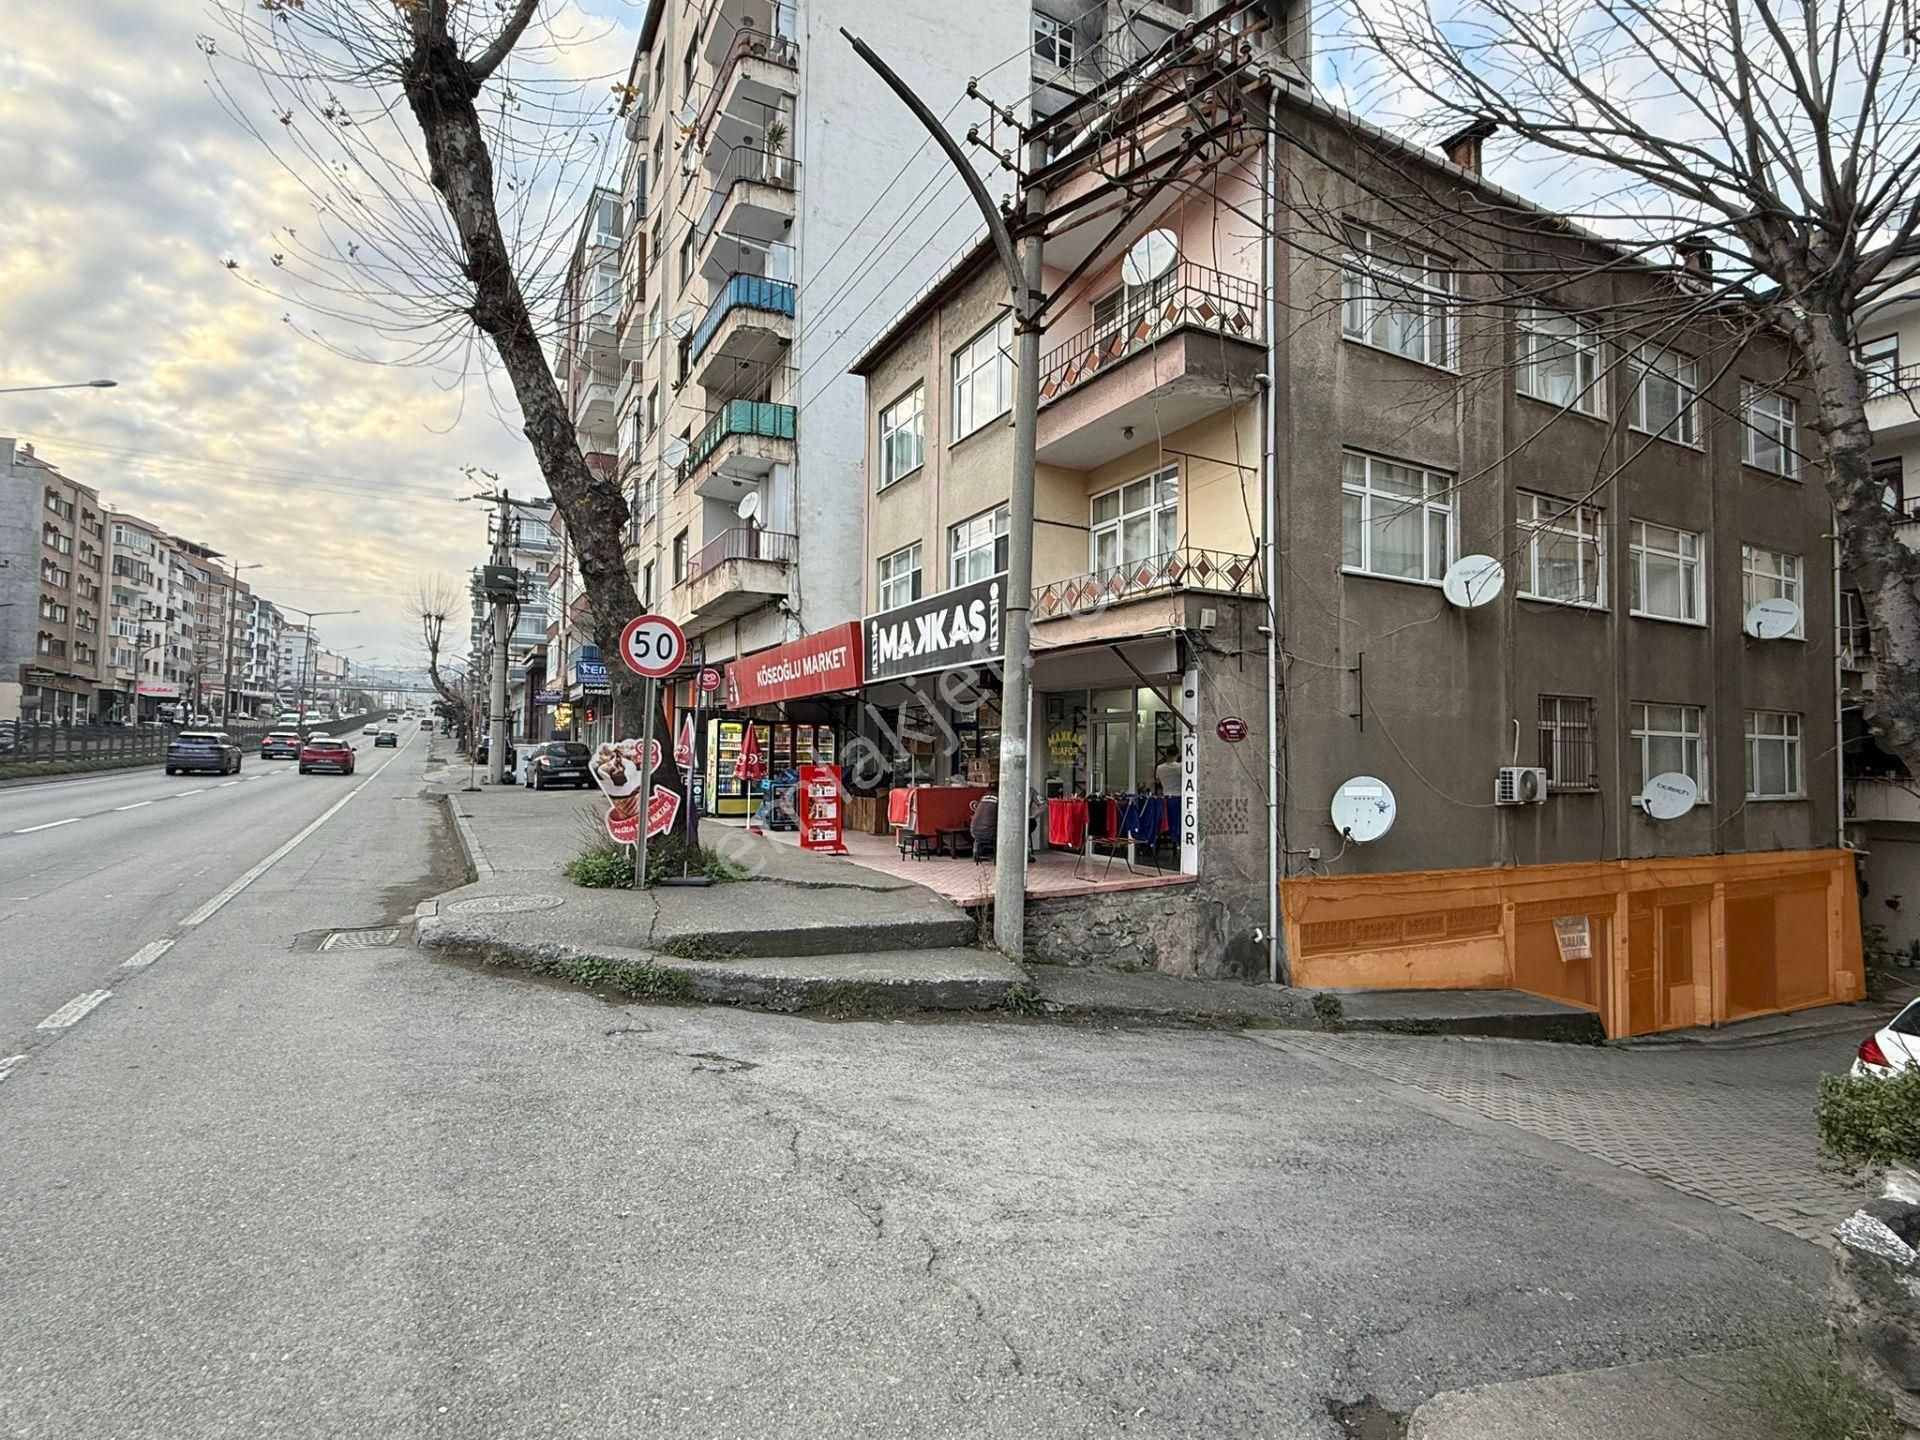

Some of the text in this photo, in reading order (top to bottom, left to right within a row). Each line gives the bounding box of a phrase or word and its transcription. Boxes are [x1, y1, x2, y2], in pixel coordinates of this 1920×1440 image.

[634, 630, 673, 660] 50
[879, 599, 987, 664] MAKKAS
[756, 646, 847, 687] KÖSEOĞLU MARKET
[1185, 743, 1195, 846] KUAFÖR
